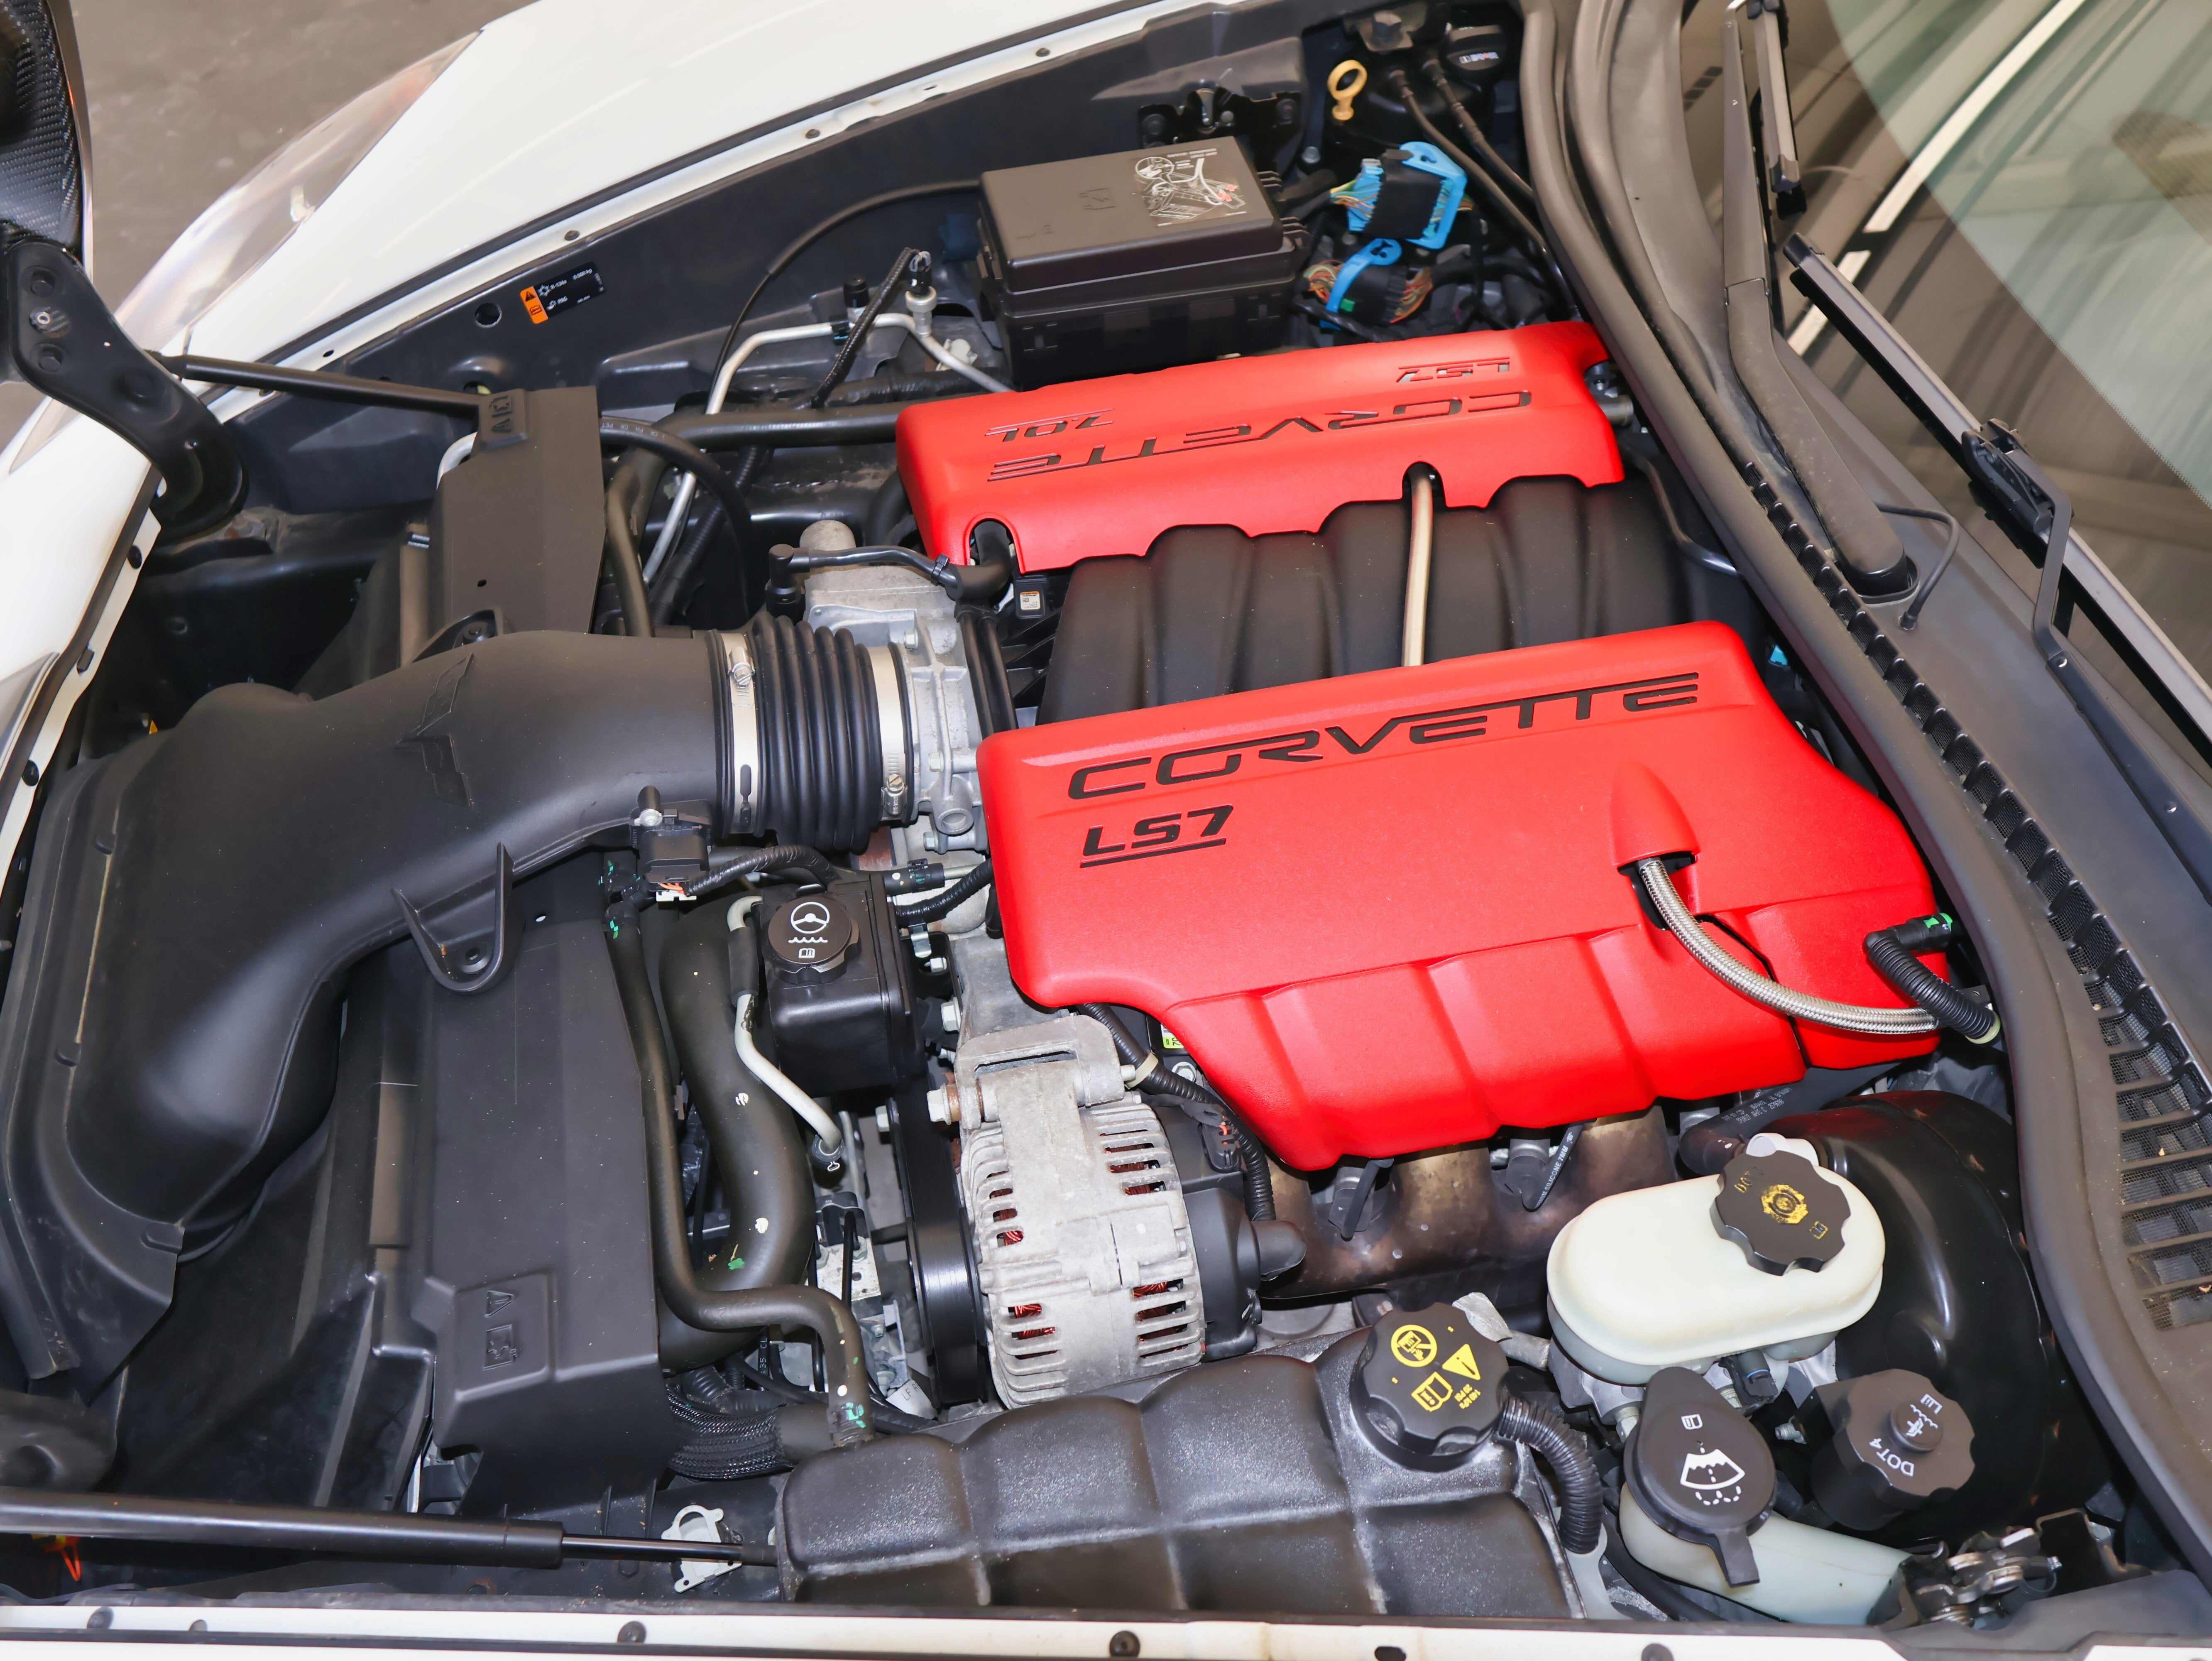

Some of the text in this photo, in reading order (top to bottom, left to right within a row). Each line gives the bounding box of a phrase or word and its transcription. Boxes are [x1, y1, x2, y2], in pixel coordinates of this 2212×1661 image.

[1397, 360, 1510, 383] LS7
[985, 414, 1113, 442] 7.0L
[987, 390, 1532, 482] CORVETTE
[1068, 671, 1698, 800] CORVETTE
[1083, 803, 1233, 857] LS7
[1544, 1161, 1561, 1190] SILICONE
[1558, 1145, 1569, 1161] 7MM
[1454, 1384, 1473, 1402] 20 PSI
[1869, 1438, 1914, 1477] DOT 4
